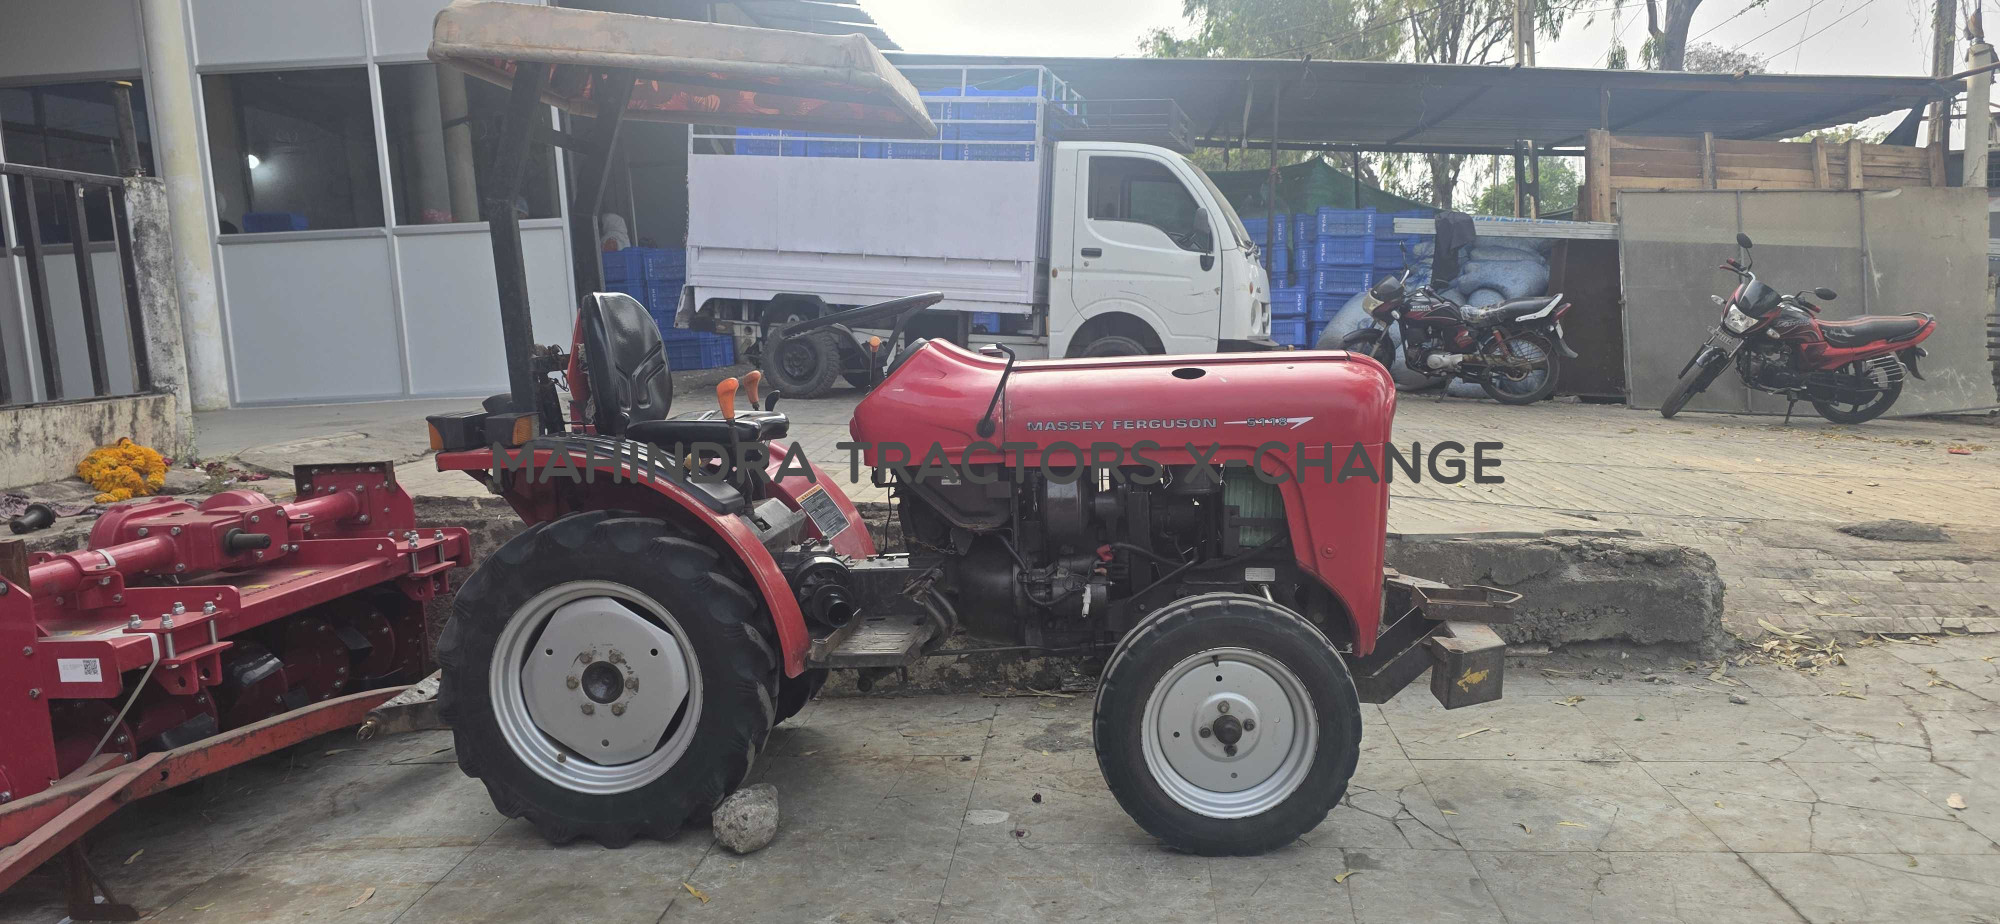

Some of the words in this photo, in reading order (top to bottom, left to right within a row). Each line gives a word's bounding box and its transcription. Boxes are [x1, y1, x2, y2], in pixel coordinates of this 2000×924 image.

[1026, 420, 1105, 431] MASSEY
[1112, 418, 1217, 430] FERGUSON
[1246, 417, 1288, 427] 5118
